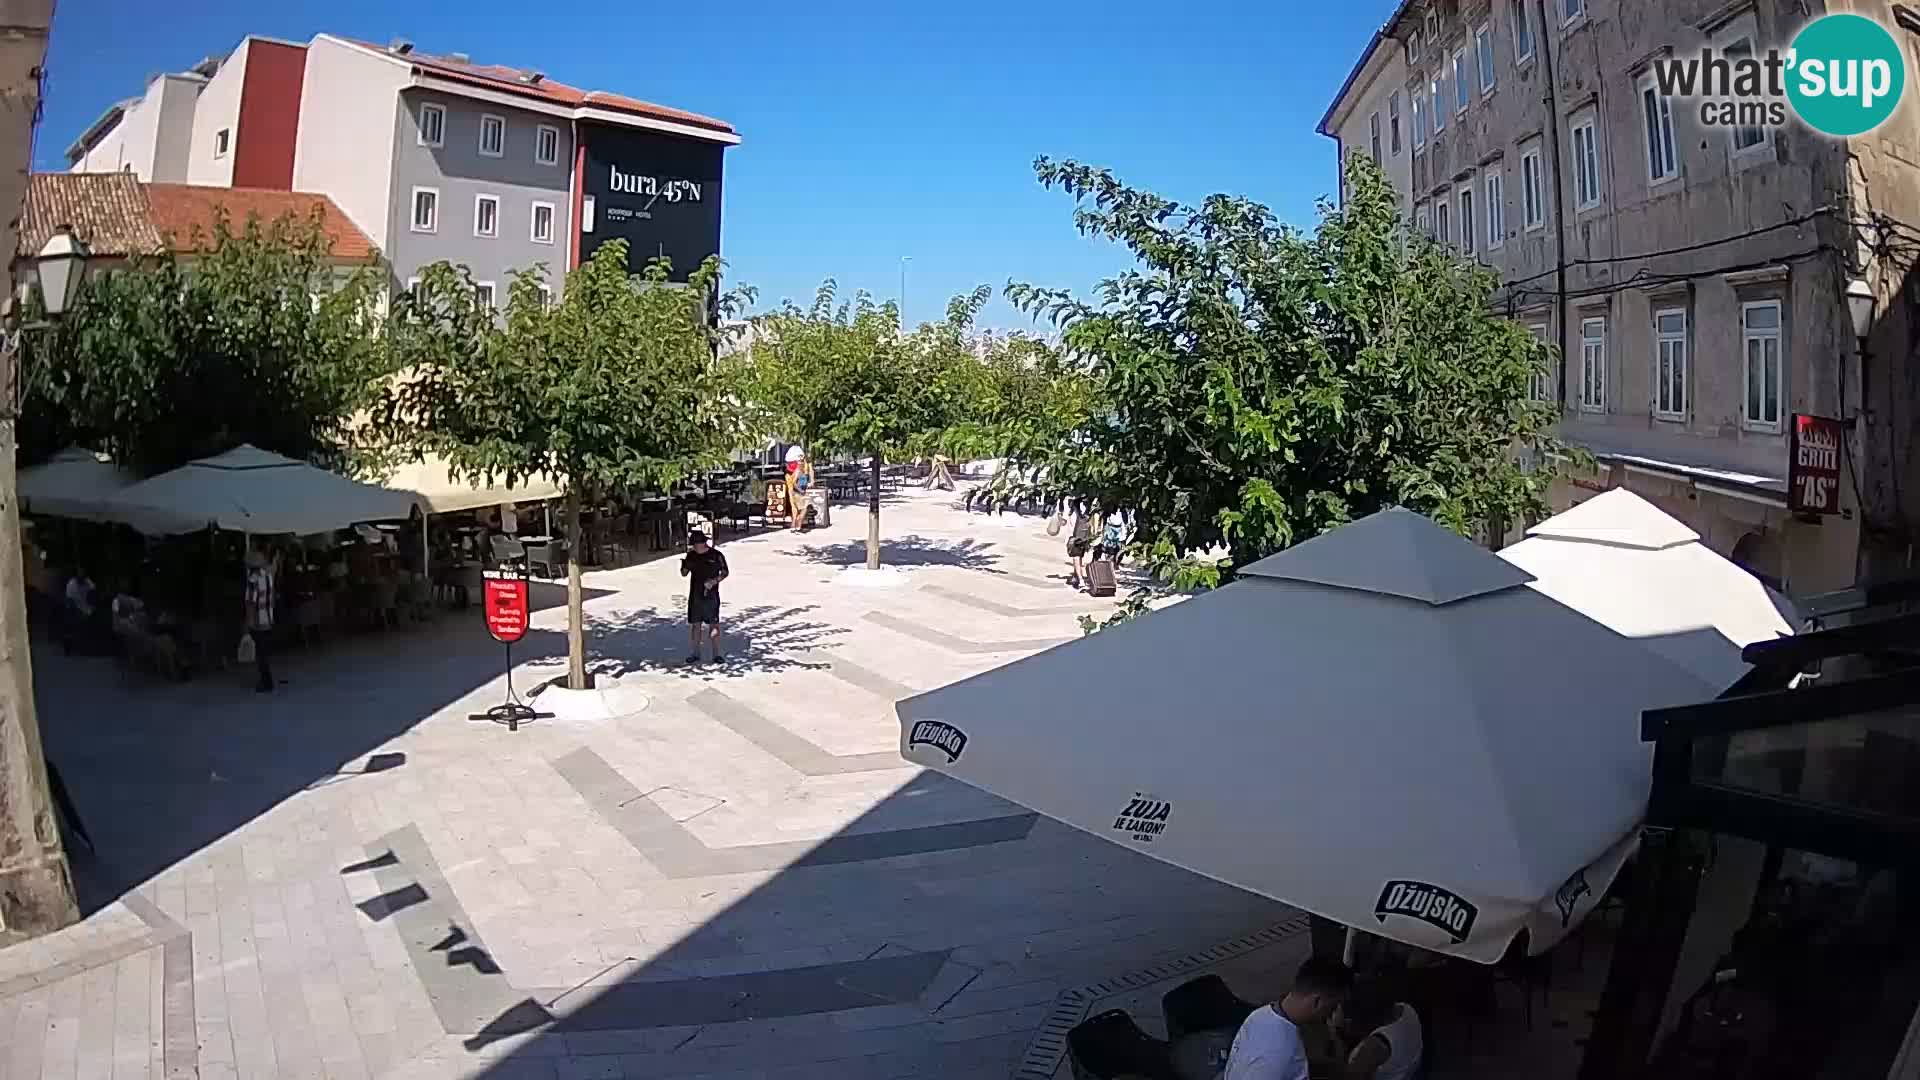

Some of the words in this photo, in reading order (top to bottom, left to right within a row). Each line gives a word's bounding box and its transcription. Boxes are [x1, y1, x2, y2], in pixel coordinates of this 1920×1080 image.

[610, 164, 657, 195] bura
[914, 722, 961, 753] Ožujsko
[1120, 792, 1171, 821] ŽUJA
[1113, 817, 1126, 829] JE
[1125, 819, 1166, 835] ZAKON!
[1386, 883, 1468, 931] Ožujsko
